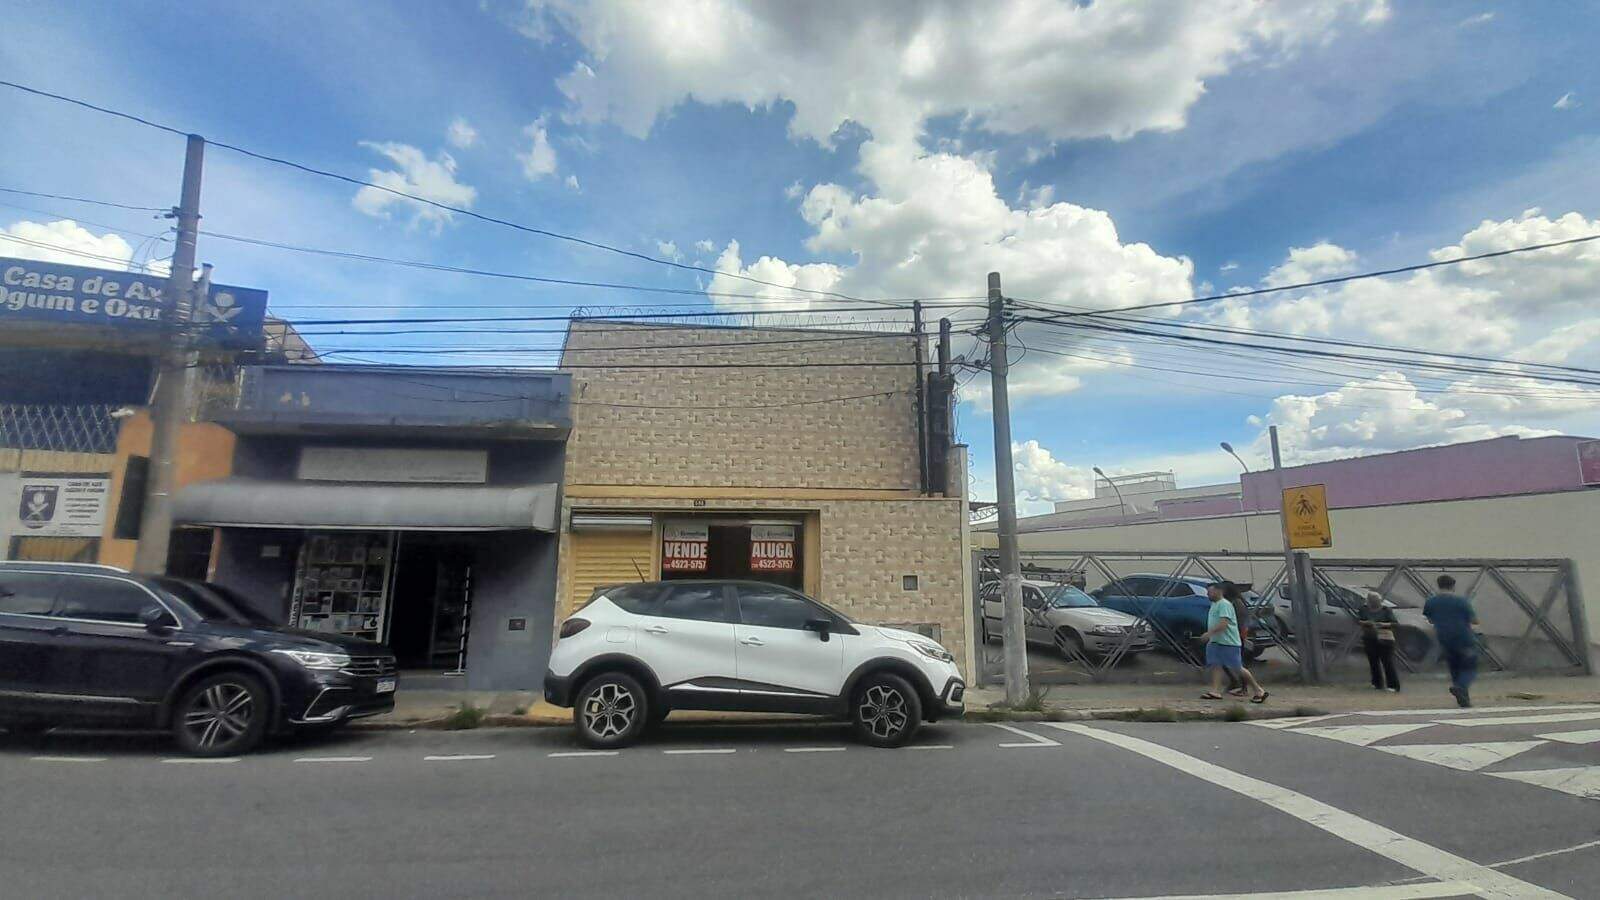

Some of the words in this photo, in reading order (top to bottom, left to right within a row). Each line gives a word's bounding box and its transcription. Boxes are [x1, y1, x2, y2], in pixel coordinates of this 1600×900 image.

[4, 266, 75, 291] Casa
[81, 276, 120, 297] de
[125, 281, 162, 302] Ax
[81, 299, 99, 314] e
[105, 299, 161, 321] Oxu
[664, 542, 708, 558] VENDE
[752, 542, 793, 558] ALUGA
[671, 559, 707, 569] 4523-5757
[759, 559, 793, 569] 4523-5757
